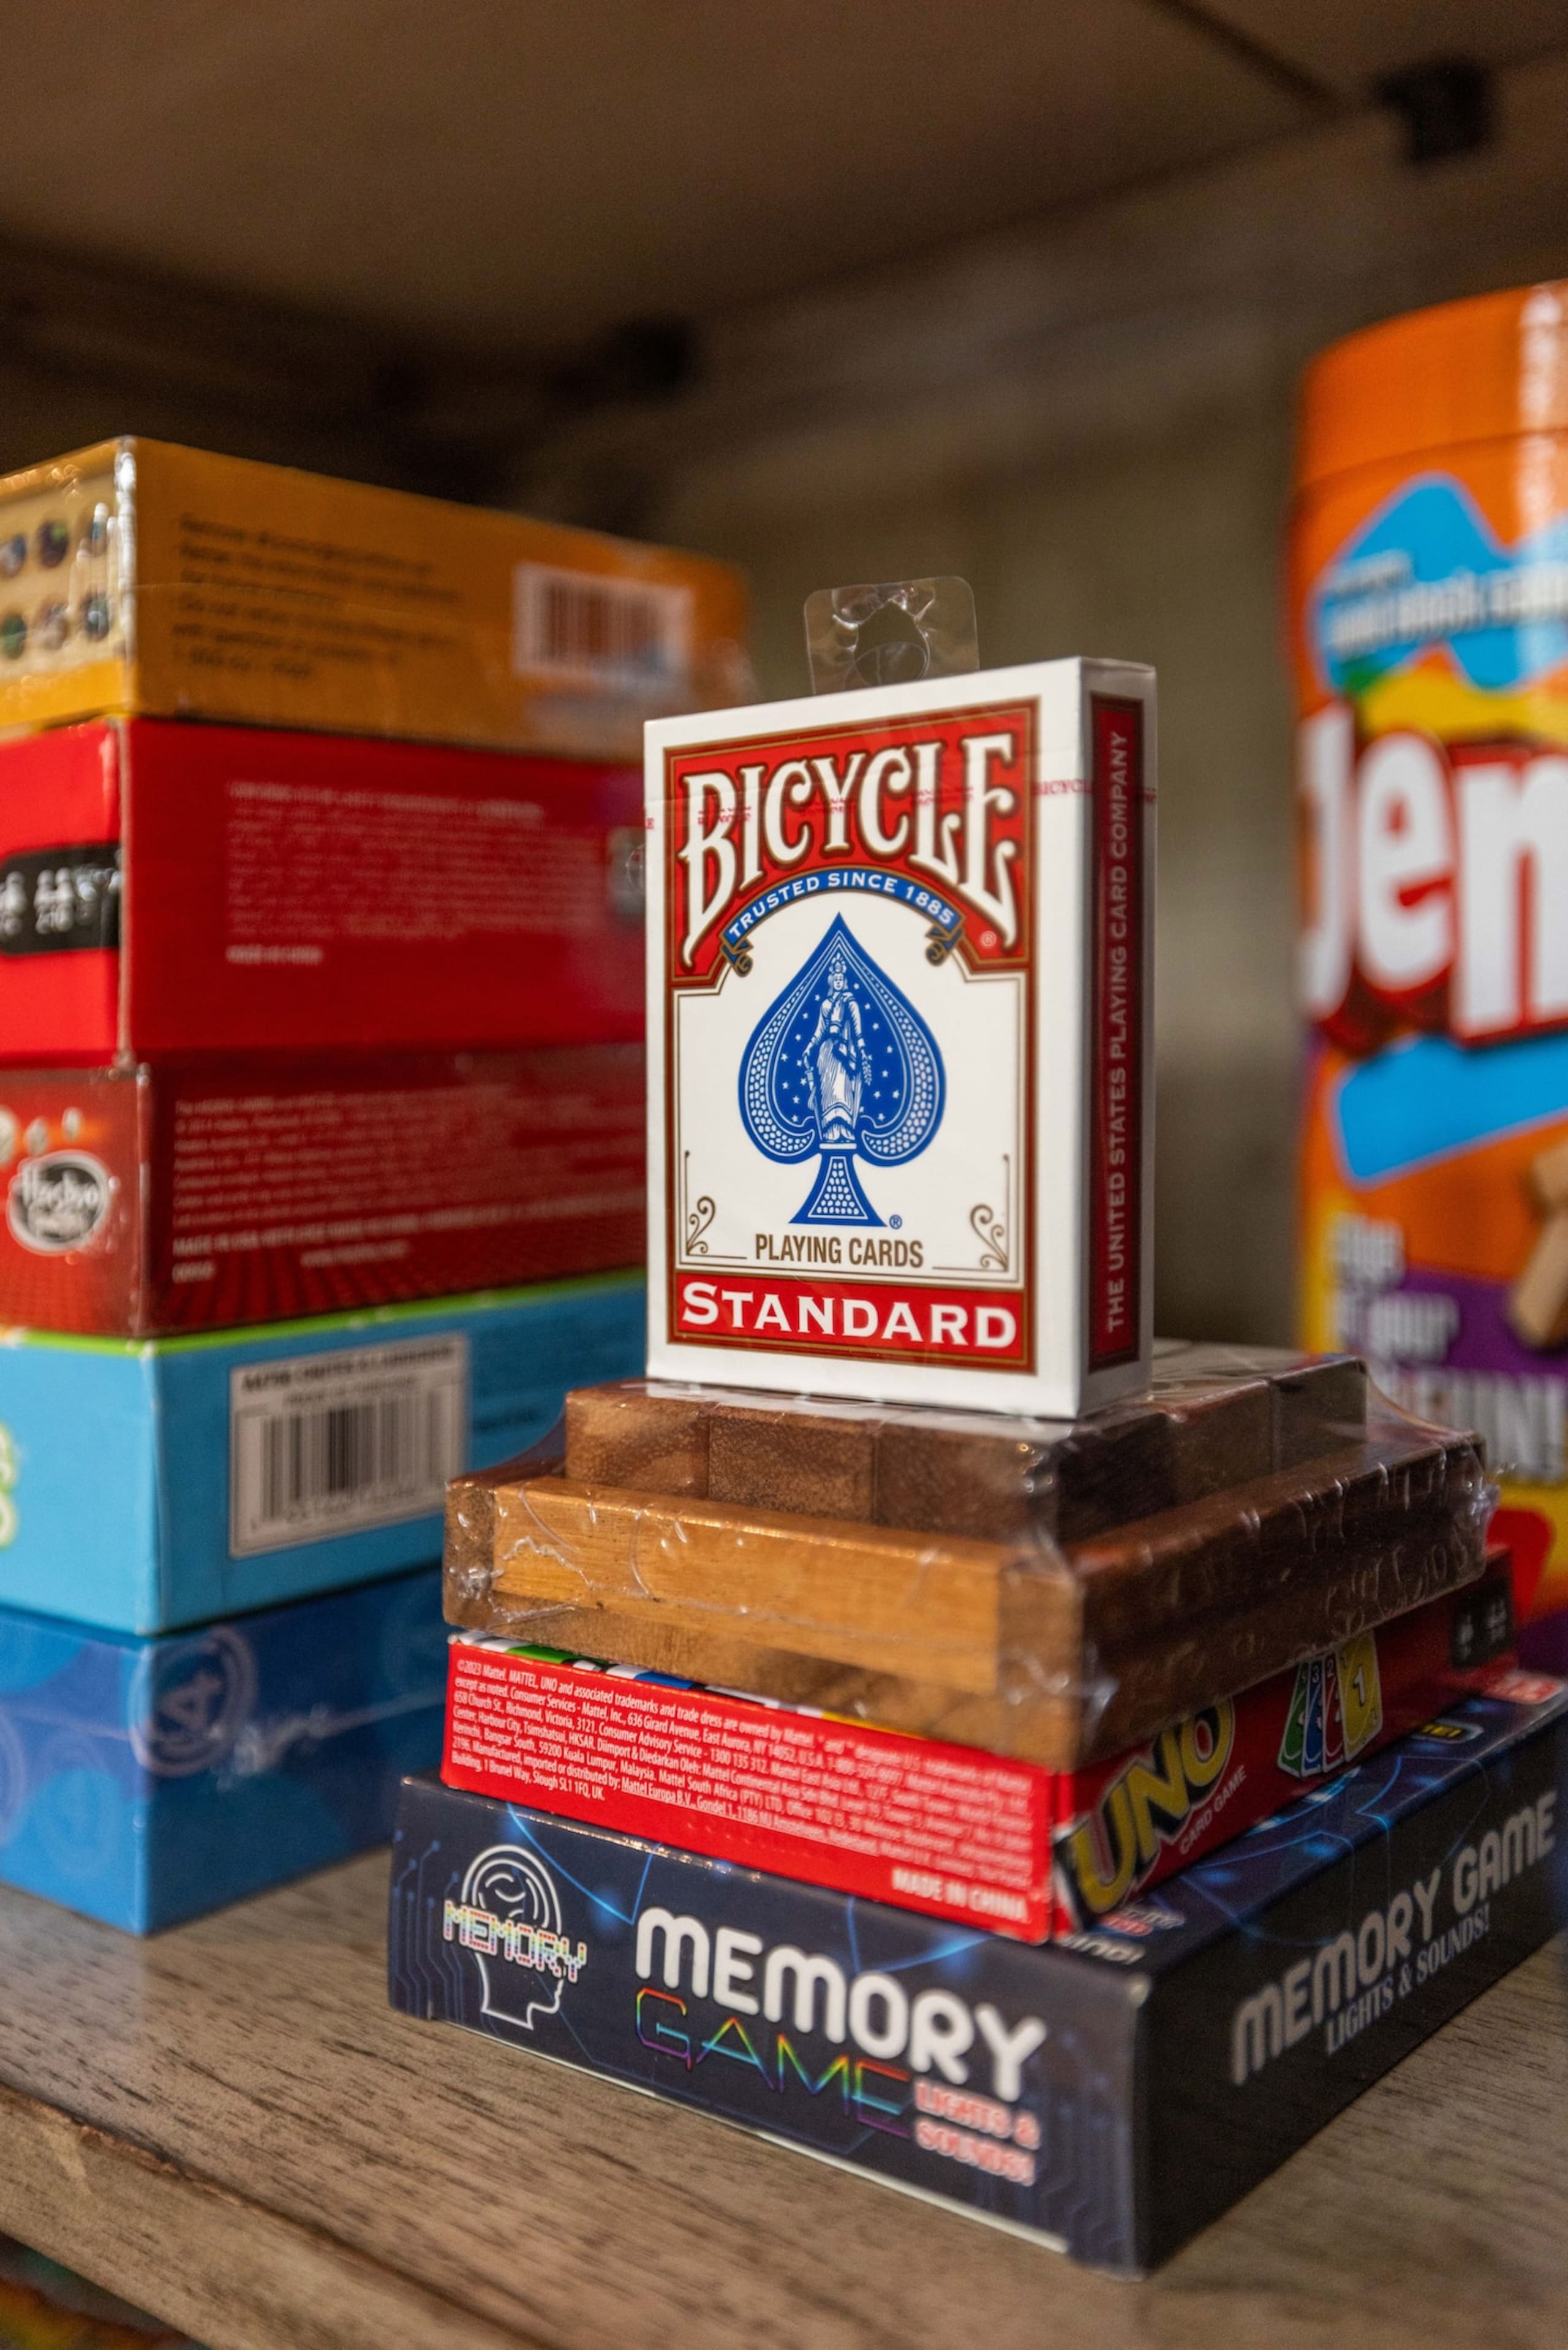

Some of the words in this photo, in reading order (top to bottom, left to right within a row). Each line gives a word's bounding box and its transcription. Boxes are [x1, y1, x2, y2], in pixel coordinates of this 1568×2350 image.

[1111, 731, 1128, 858] COMPANY
[677, 733, 1017, 968] BICYCLE
[728, 876, 821, 939] TRUSTED
[827, 872, 898, 893] SINCE
[905, 886, 954, 925] 1885
[1112, 866, 1128, 939] CARD
[1111, 946, 1128, 1059] PLAYING
[1110, 1068, 1126, 1164] STATES
[755, 1233, 842, 1264] PLAYING
[848, 1237, 924, 1268] CARDS
[1109, 1172, 1126, 1272] UNITED
[682, 1281, 1017, 1348] STANDARD
[1107, 1279, 1125, 1333] THE
[509, 1670, 537, 1690] MATTEL,
[540, 1677, 557, 1691] UNO
[559, 1682, 573, 1695] and
[575, 1687, 612, 1704] associated
[615, 1692, 657, 1713] trademarks
[660, 1704, 675, 1717] and
[677, 1706, 698, 1722] trade
[700, 1710, 721, 1727] dress
[723, 1718, 737, 1731] are
[510, 1687, 545, 1706] Consumer
[546, 1694, 575, 1712] Services
[582, 1702, 608, 1721] Mattel,
[627, 1712, 642, 1727] 636
[644, 1715, 667, 1732] Girard
[669, 1721, 700, 1742] Avenue,
[703, 1728, 720, 1745] East
[545, 1710, 573, 1730] Victoria,
[576, 1718, 596, 1733] 3121.
[599, 1723, 636, 1742] Consumer
[639, 1731, 671, 1753] Advisory
[674, 1739, 701, 1757] Service
[710, 1747, 730, 1764] 1300
[533, 1771, 557, 1789] Slough
[539, 1742, 561, 1757] 59200
[564, 1747, 584, 1762] Kuala
[587, 1753, 617, 1773] Lumpur,
[620, 1761, 656, 1780] Malaysia.
[659, 1770, 685, 1787] Mattel
[688, 1776, 711, 1793] South
[714, 1783, 737, 1799] Africa
[567, 1764, 607, 1785] distributed
[622, 1777, 647, 1794] Mattel
[649, 1783, 674, 1803] Europa
[639, 1748, 678, 1769] Diedarkan
[1071, 1698, 1231, 1913] UNO
[1180, 1808, 1213, 1855] CARD
[1214, 1764, 1248, 1813] GAME
[892, 1867, 943, 1902] MADE
[944, 1881, 968, 1908] IN
[968, 1887, 1029, 1924] CHINA
[442, 1899, 587, 1984] MEMORY
[1232, 1867, 1441, 2085] MEMORY
[1453, 1789, 1557, 1915] GAME
[636, 1906, 1046, 2101] MEMORY
[1327, 1974, 1393, 2057] LIGHTS
[1398, 1963, 1412, 1998] &
[1416, 1901, 1490, 1984] SOUNDS!
[636, 1987, 911, 2138] GAME
